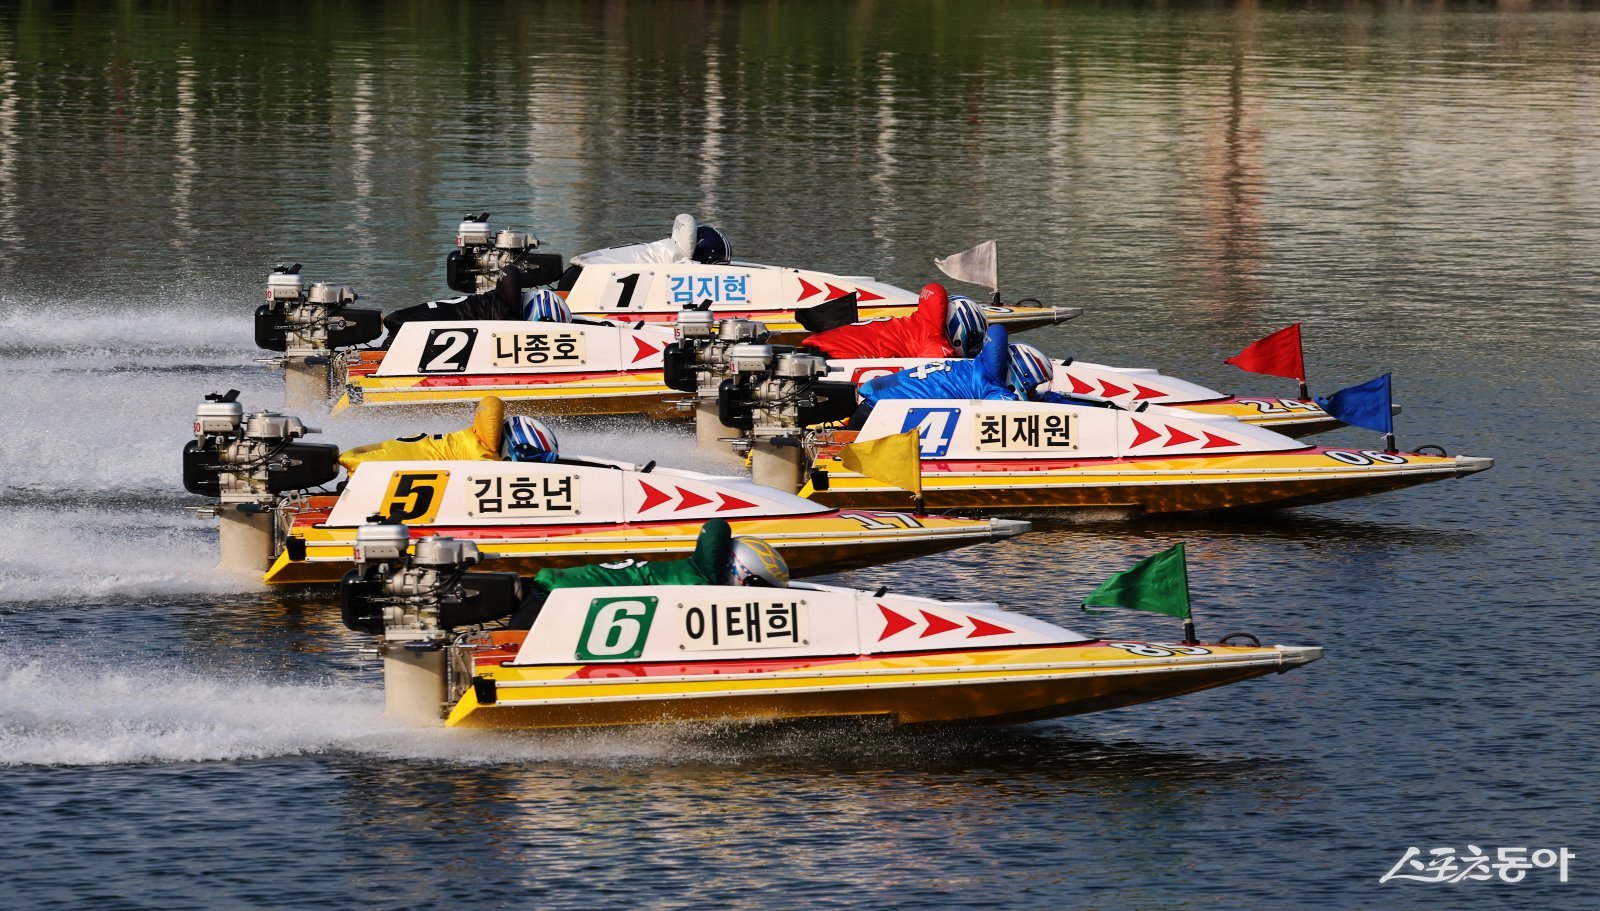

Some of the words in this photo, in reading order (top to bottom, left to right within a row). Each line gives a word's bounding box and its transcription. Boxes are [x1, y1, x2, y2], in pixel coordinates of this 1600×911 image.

[616, 273, 641, 307] 1
[670, 275, 746, 303] 김지현
[425, 331, 470, 371] 2
[495, 334, 579, 364] 나종호
[1238, 399, 1319, 414] 24
[918, 410, 949, 454] 4
[979, 414, 1071, 448] 최재원
[1323, 449, 1408, 466] 06
[390, 474, 440, 520] 5
[474, 475, 572, 513] 김효년
[840, 513, 924, 530] 17
[586, 600, 648, 656] 6
[686, 601, 798, 645] 이태희
